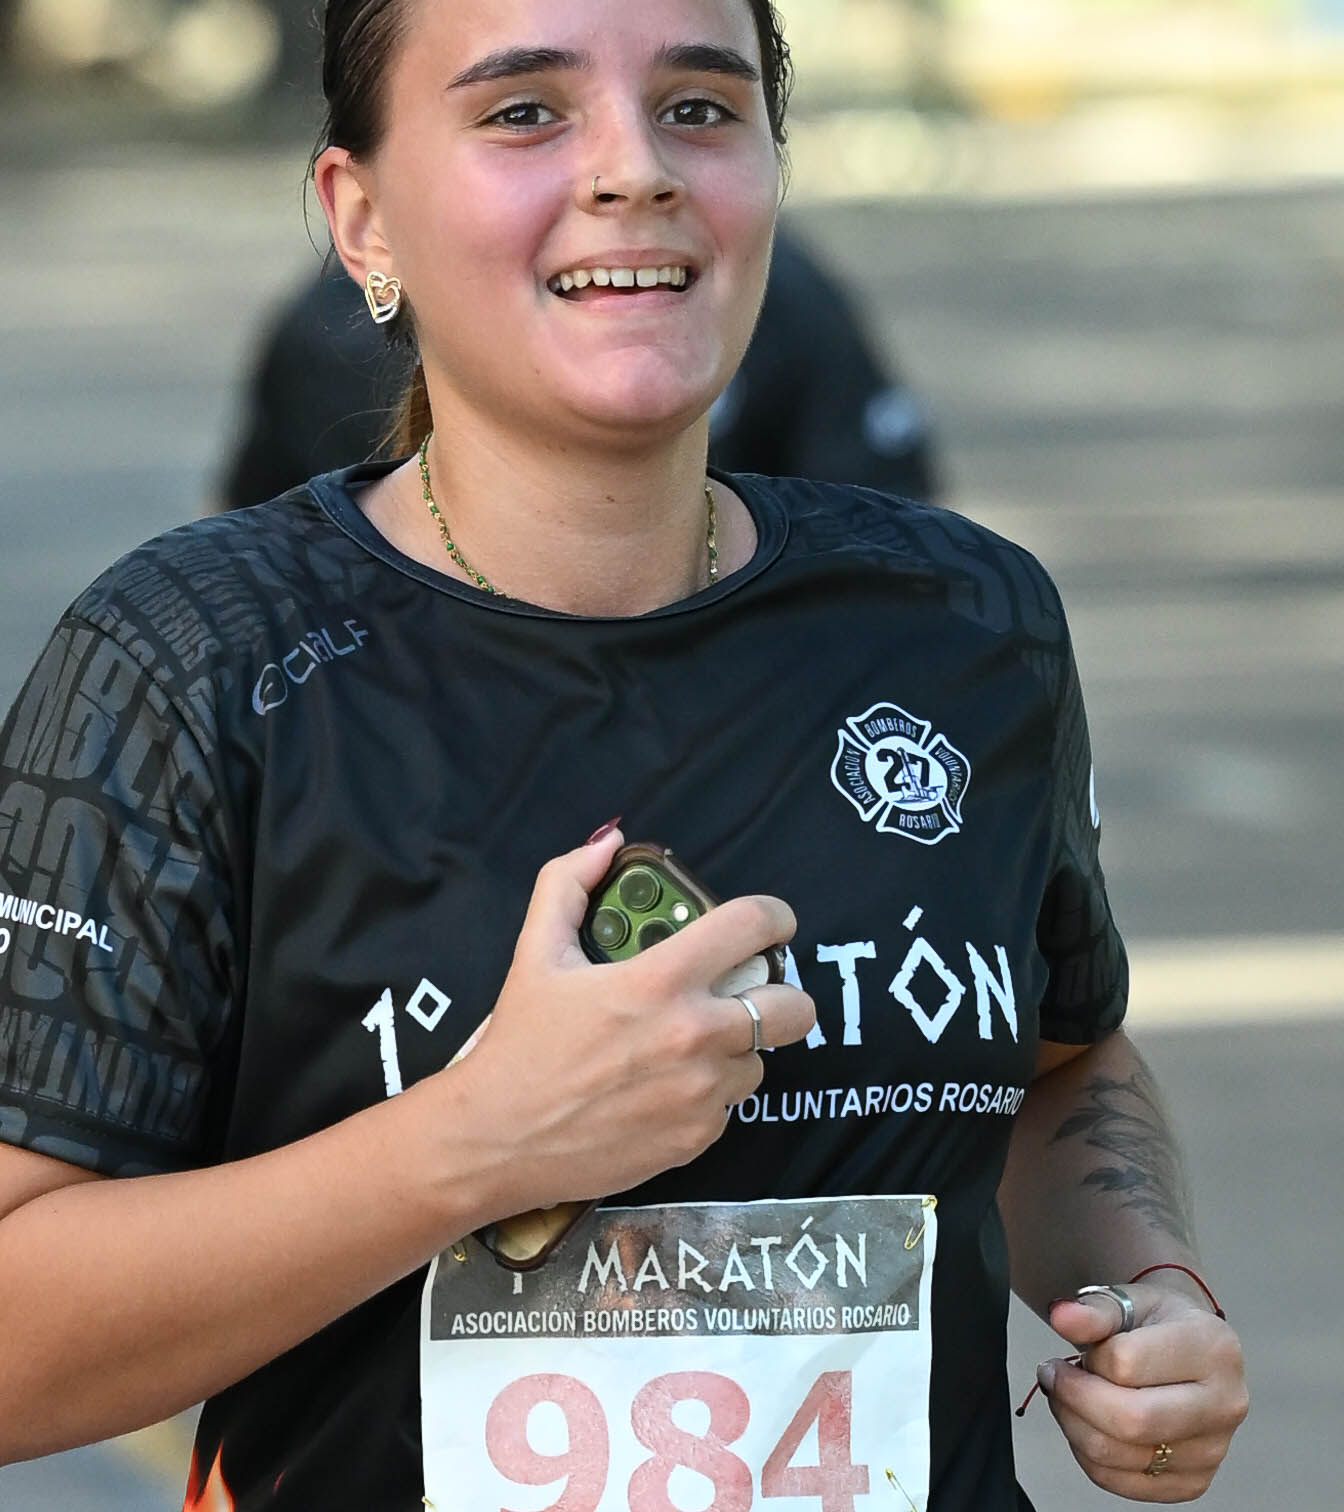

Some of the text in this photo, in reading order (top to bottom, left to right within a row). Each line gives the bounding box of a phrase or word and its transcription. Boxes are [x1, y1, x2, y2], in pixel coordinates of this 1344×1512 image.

[865, 718, 918, 738] BOMBEROS
[876, 747, 930, 793] 27
[937, 1081, 1026, 1118] ROSARIO
[576, 1215, 869, 1294] MARATÓN
[450, 1302, 912, 1336] ASOCIACIÓN BOMBEROS VOLUNTARIOS ROSARIO
